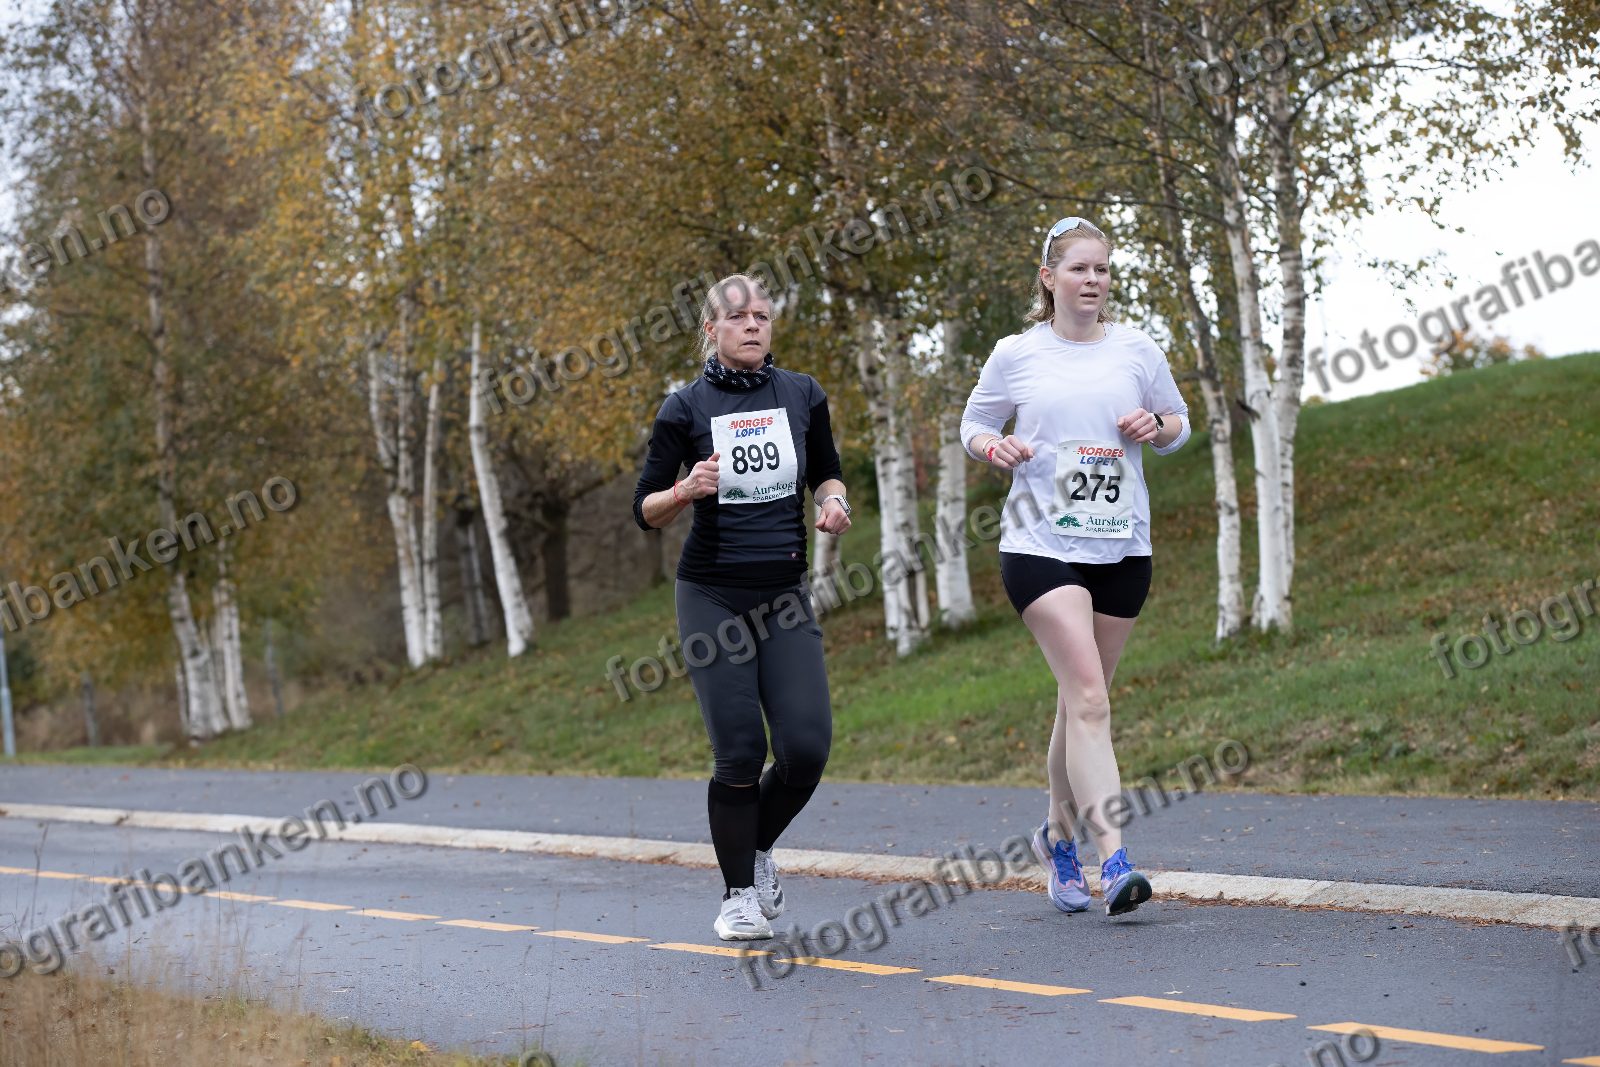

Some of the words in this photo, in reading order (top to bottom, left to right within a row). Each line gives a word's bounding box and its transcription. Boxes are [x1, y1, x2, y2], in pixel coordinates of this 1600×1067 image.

[729, 416, 774, 430] NORGES
[735, 426, 767, 438] LØPET
[732, 441, 780, 475] 899
[1077, 446, 1124, 458] NORGES
[1080, 455, 1117, 466] LØPET
[1070, 471, 1121, 503] 275
[1086, 515, 1129, 530] Aurskog
